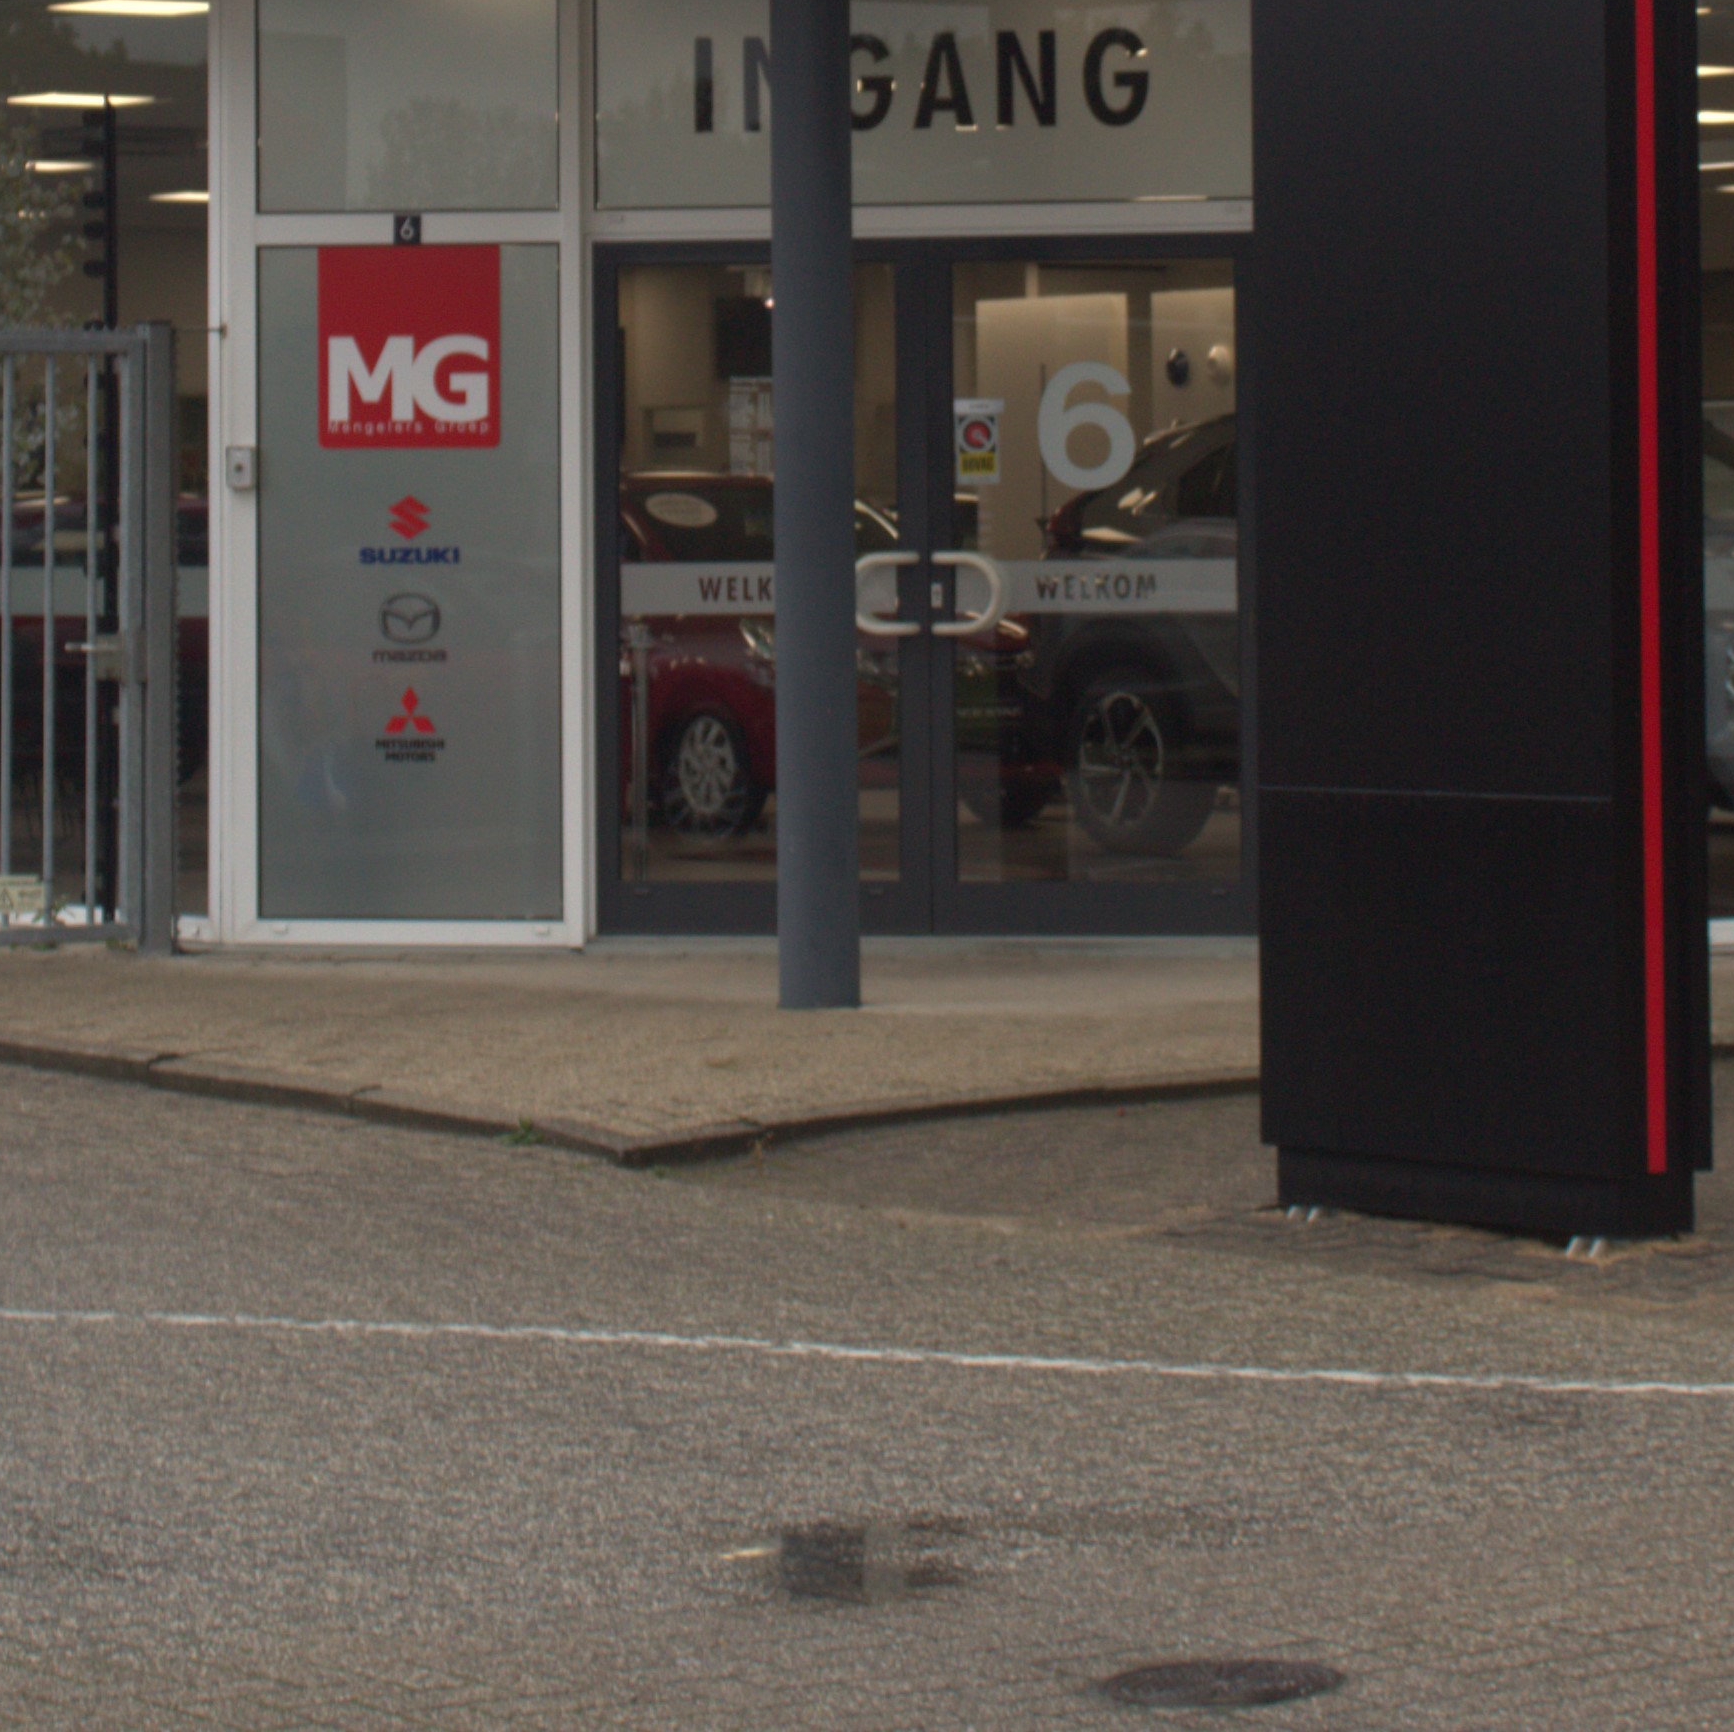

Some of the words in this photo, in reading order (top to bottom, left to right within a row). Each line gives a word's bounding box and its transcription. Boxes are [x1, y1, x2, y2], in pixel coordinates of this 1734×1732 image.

[399, 217, 415, 240] 6
[327, 333, 489, 423] MG
[1037, 361, 1136, 490] 6
[359, 546, 461, 564] SUZUKI
[698, 575, 773, 602] WELK
[1035, 573, 1157, 600] WELKOM
